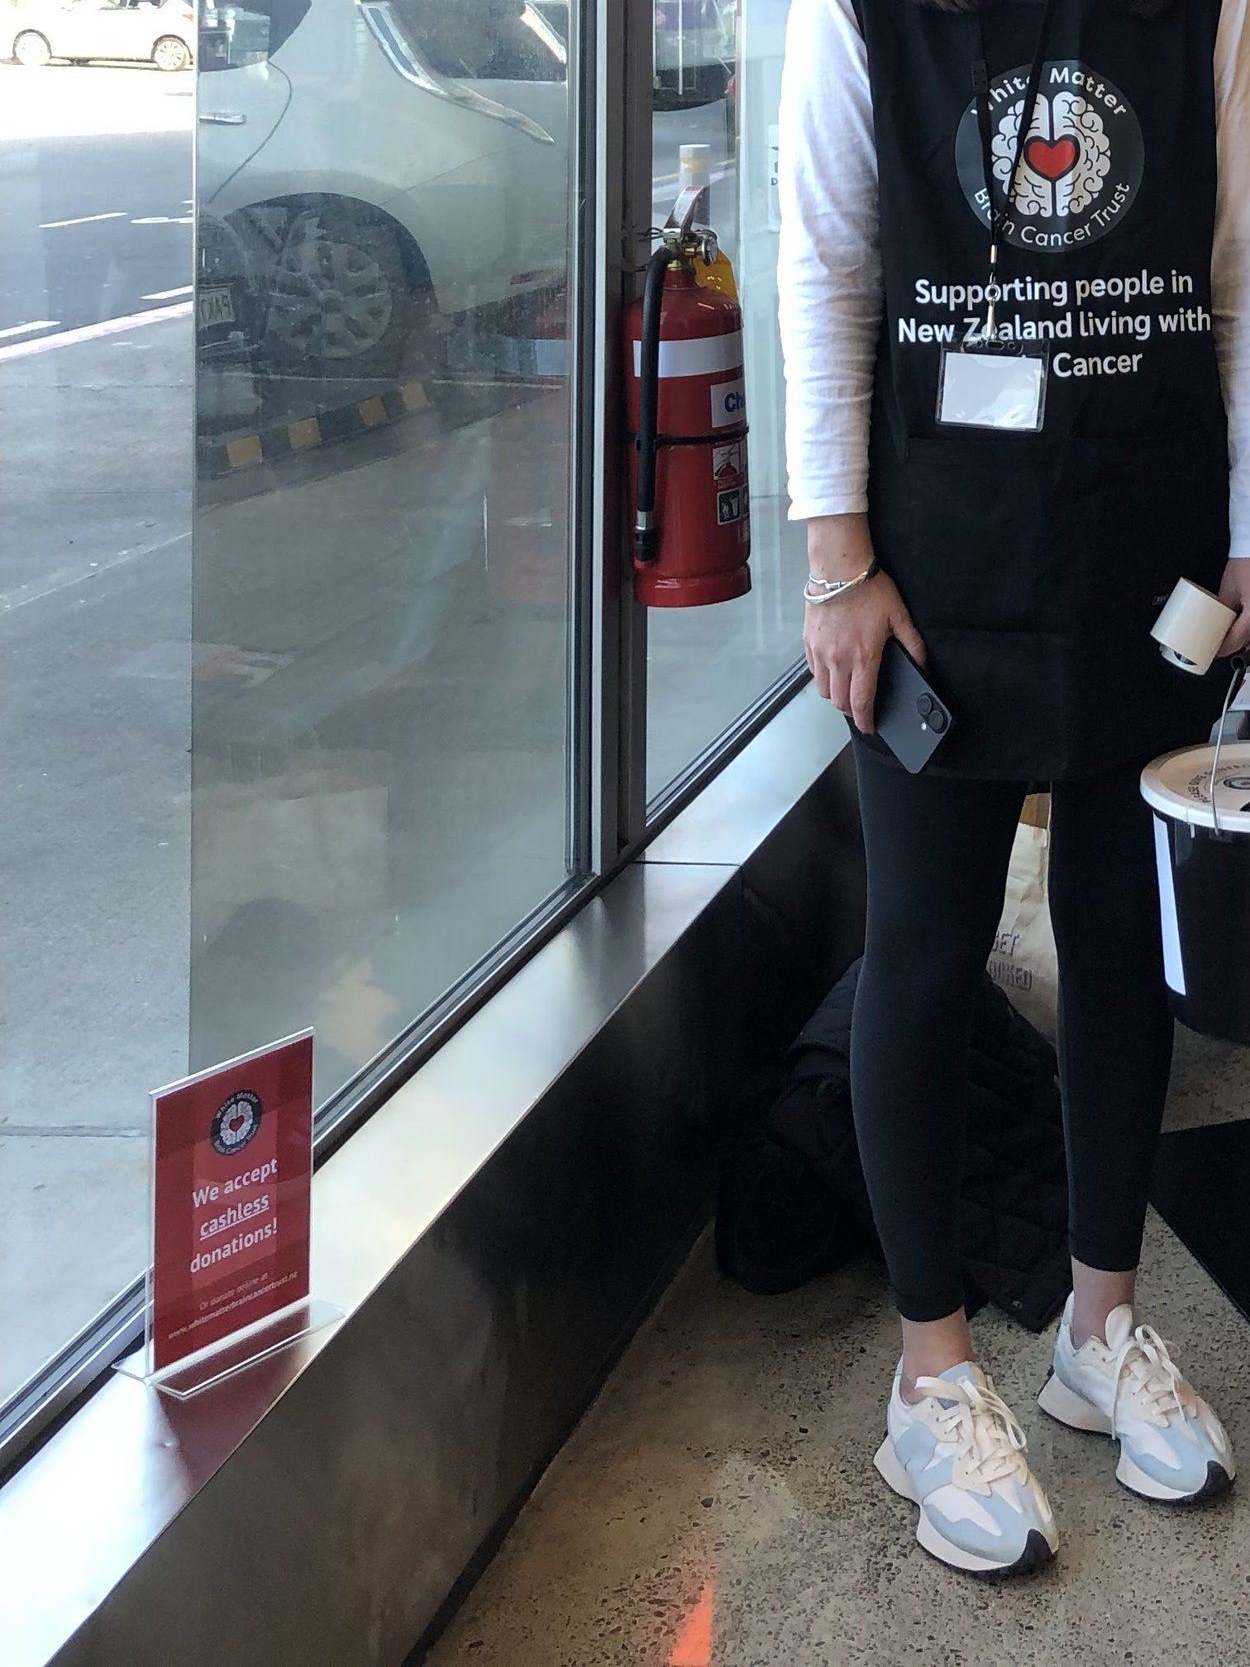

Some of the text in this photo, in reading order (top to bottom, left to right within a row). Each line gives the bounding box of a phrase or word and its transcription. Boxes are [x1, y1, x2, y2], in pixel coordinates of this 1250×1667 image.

[970, 67, 1127, 115] hit Matter
[974, 182, 1131, 247] Bran Cancer Trust
[914, 269, 1193, 311] Supporting people in
[898, 317, 955, 343] New
[1079, 310, 1150, 341] living
[1158, 306, 1211, 333] with
[1052, 352, 1143, 378] Cancer
[192, 1157, 278, 1209] We accept
[200, 1193, 270, 1237] cashless
[189, 1217, 278, 1274] donations!
